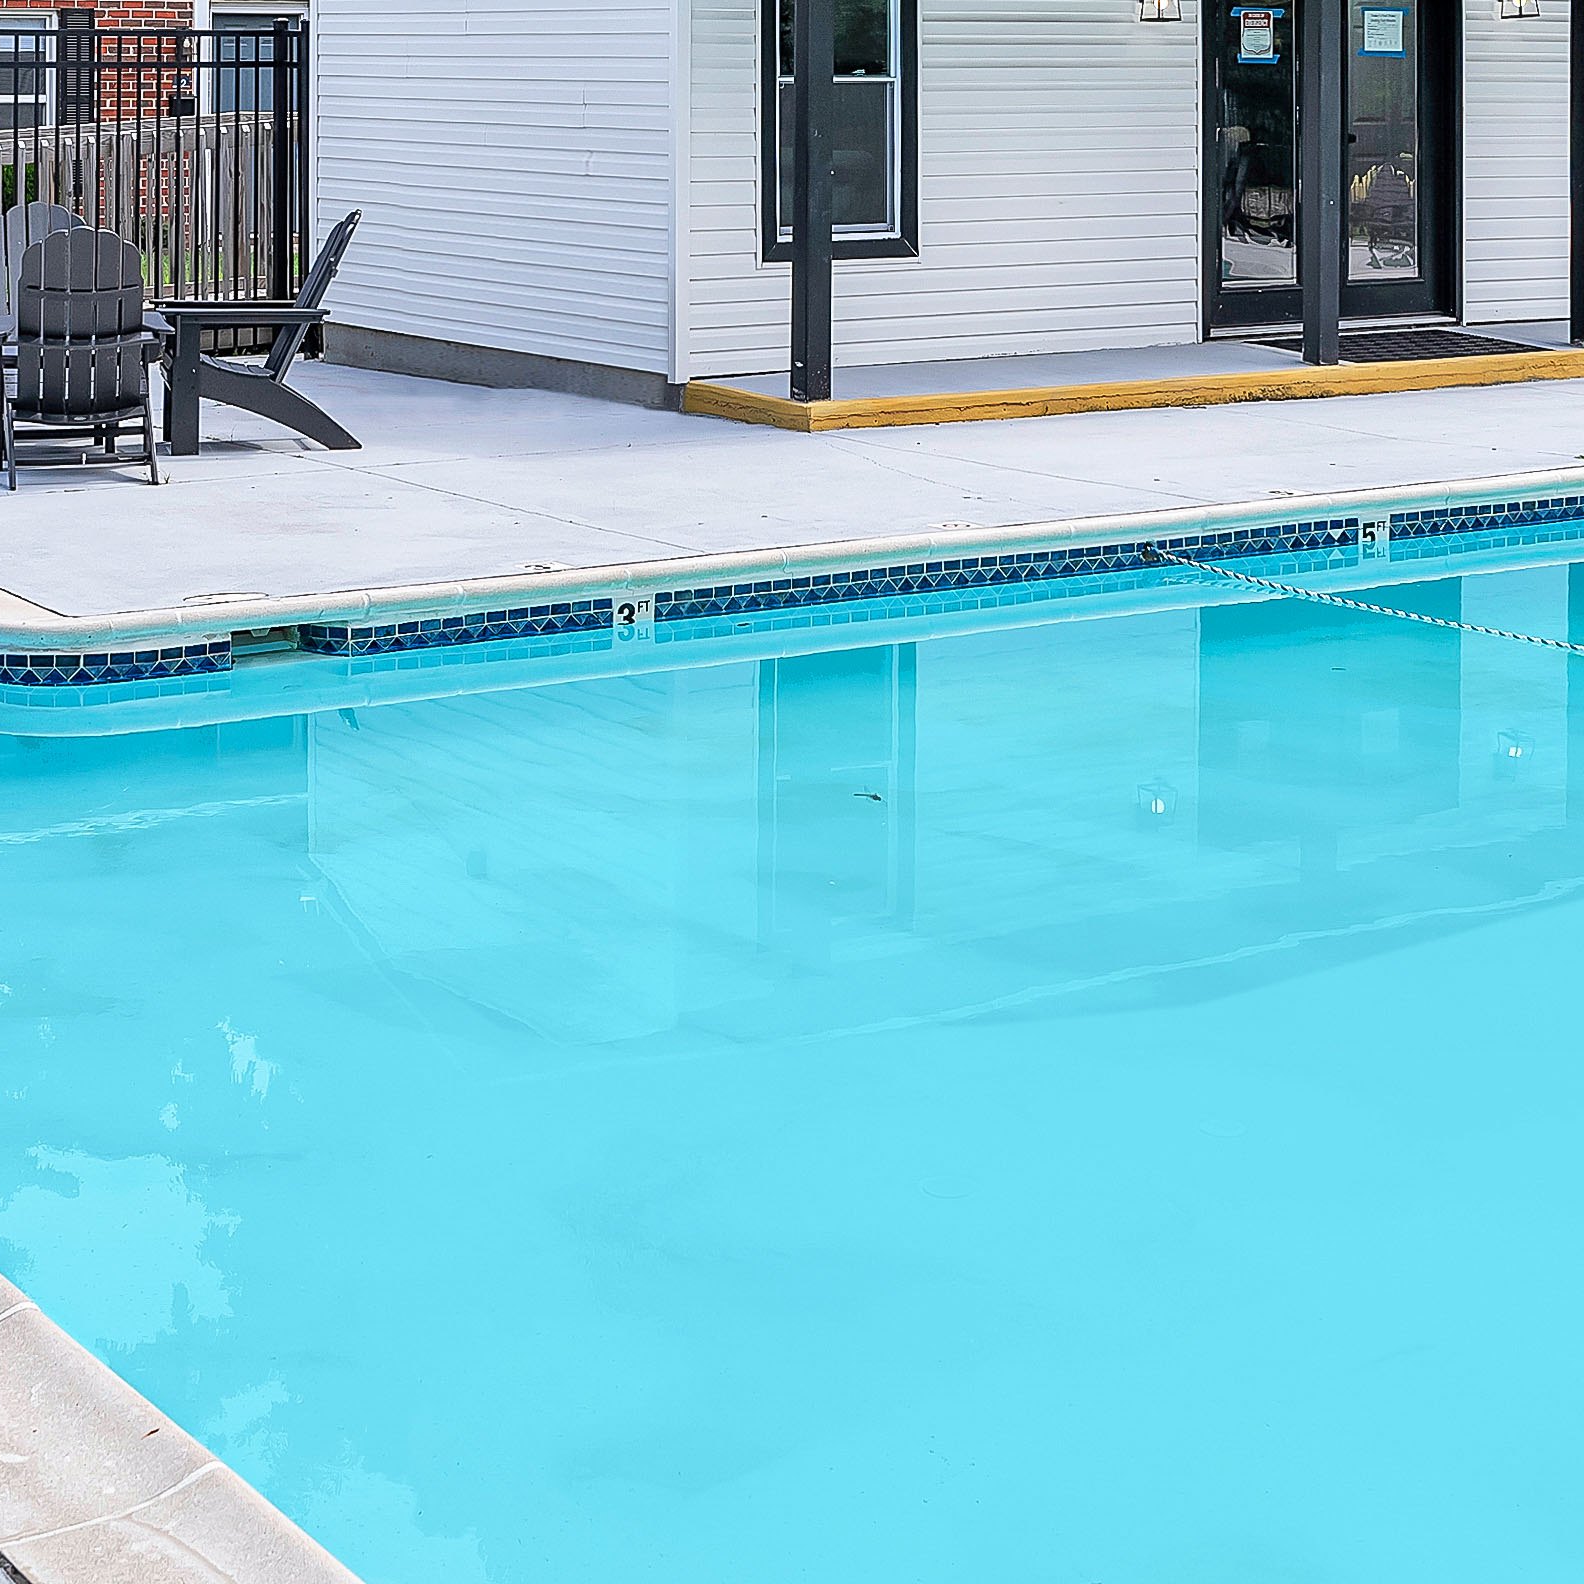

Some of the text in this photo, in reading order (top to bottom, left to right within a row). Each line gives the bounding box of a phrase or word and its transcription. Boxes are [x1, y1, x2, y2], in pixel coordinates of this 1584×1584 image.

[1362, 520, 1387, 543] 5 FT
[616, 599, 651, 626] 3 FT
